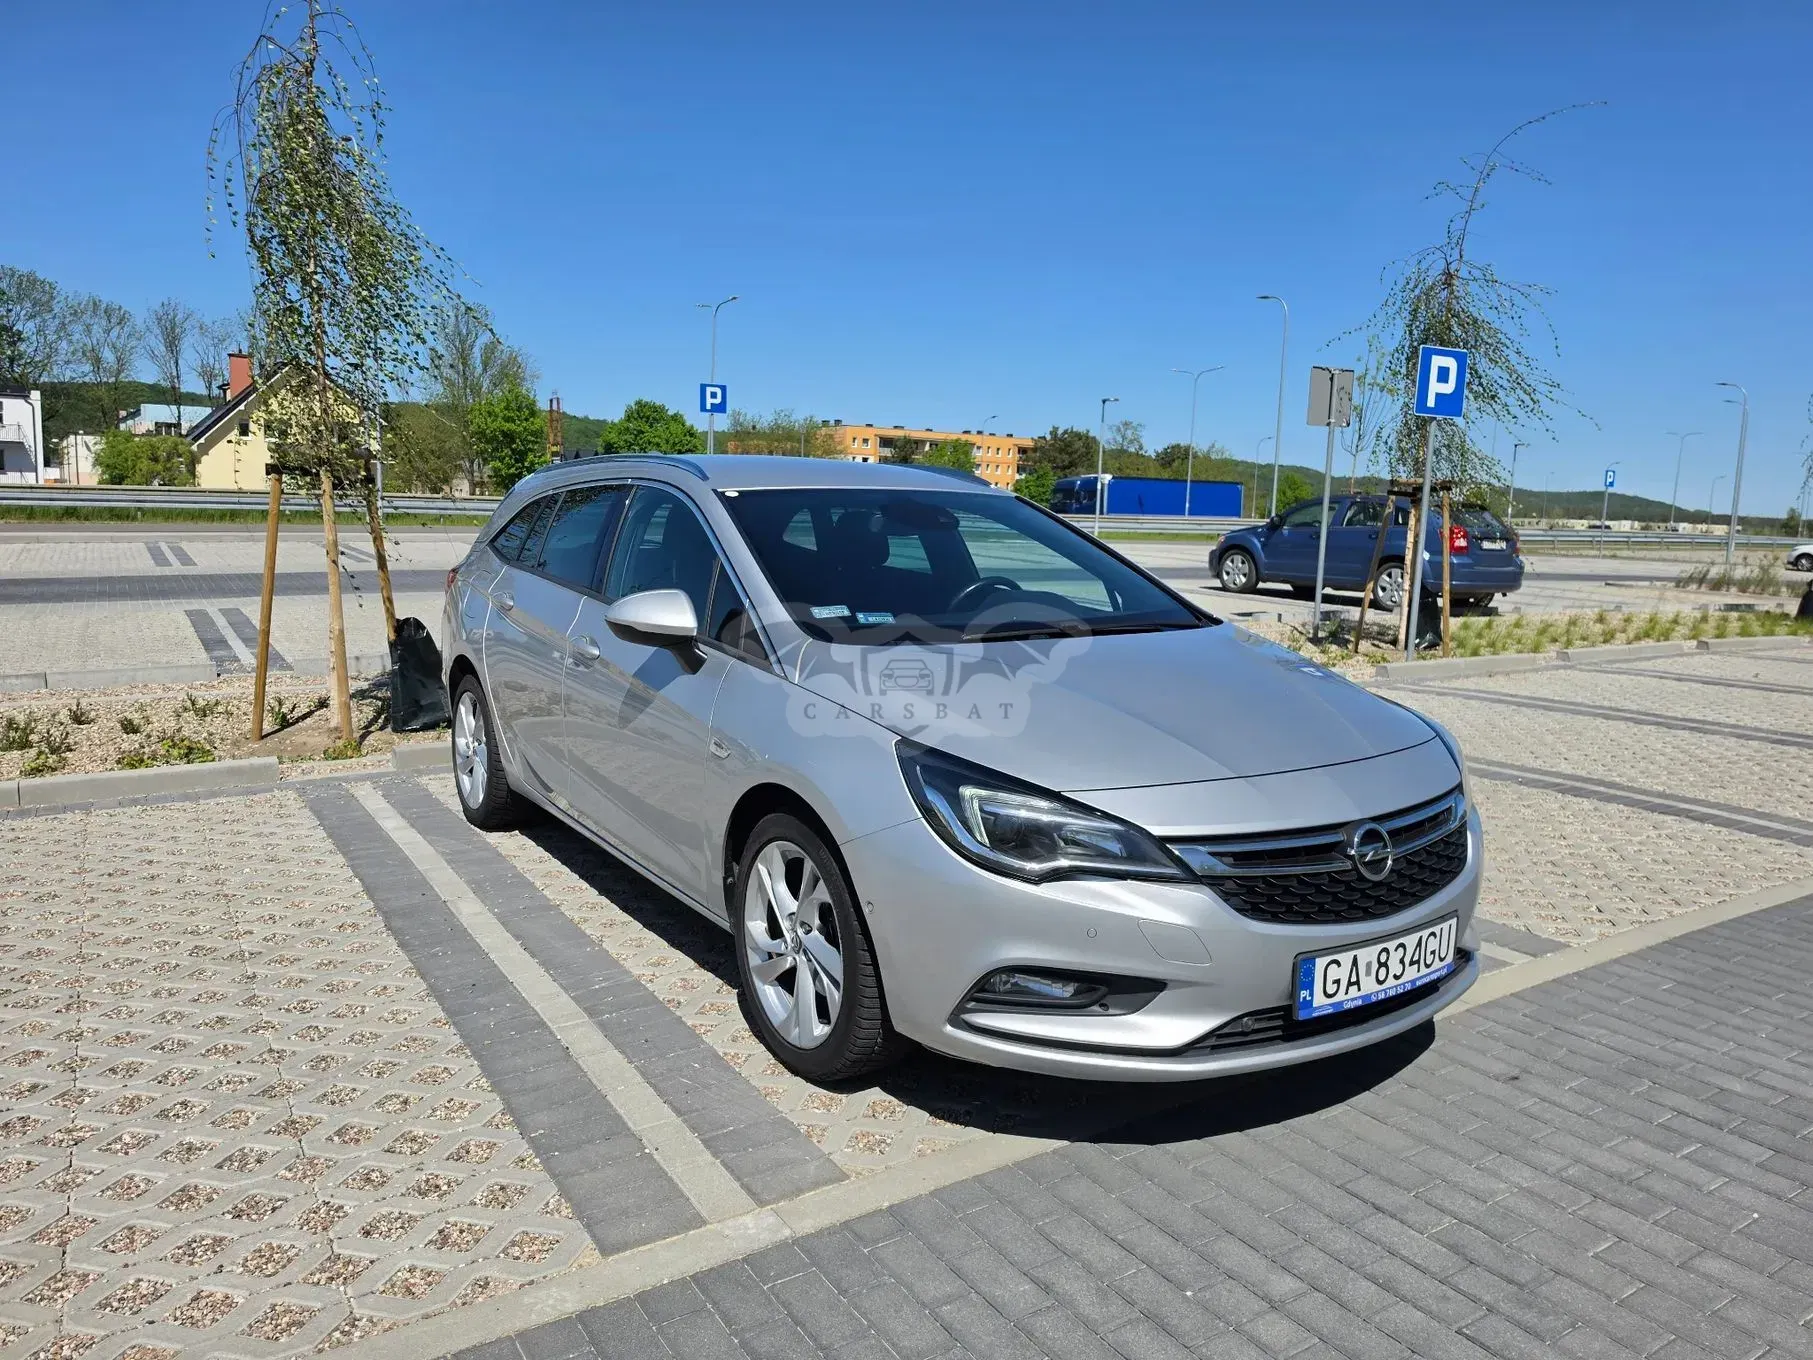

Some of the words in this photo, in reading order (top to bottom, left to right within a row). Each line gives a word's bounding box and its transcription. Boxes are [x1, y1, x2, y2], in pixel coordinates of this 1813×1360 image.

[1427, 355, 1457, 408] P
[706, 386, 722, 410] P
[1606, 471, 1614, 485] P
[1322, 954, 1362, 999] GA
[1375, 923, 1453, 985] 834GU
[1300, 989, 1312, 1002] PL
[1343, 998, 1363, 1009] Gdynia
